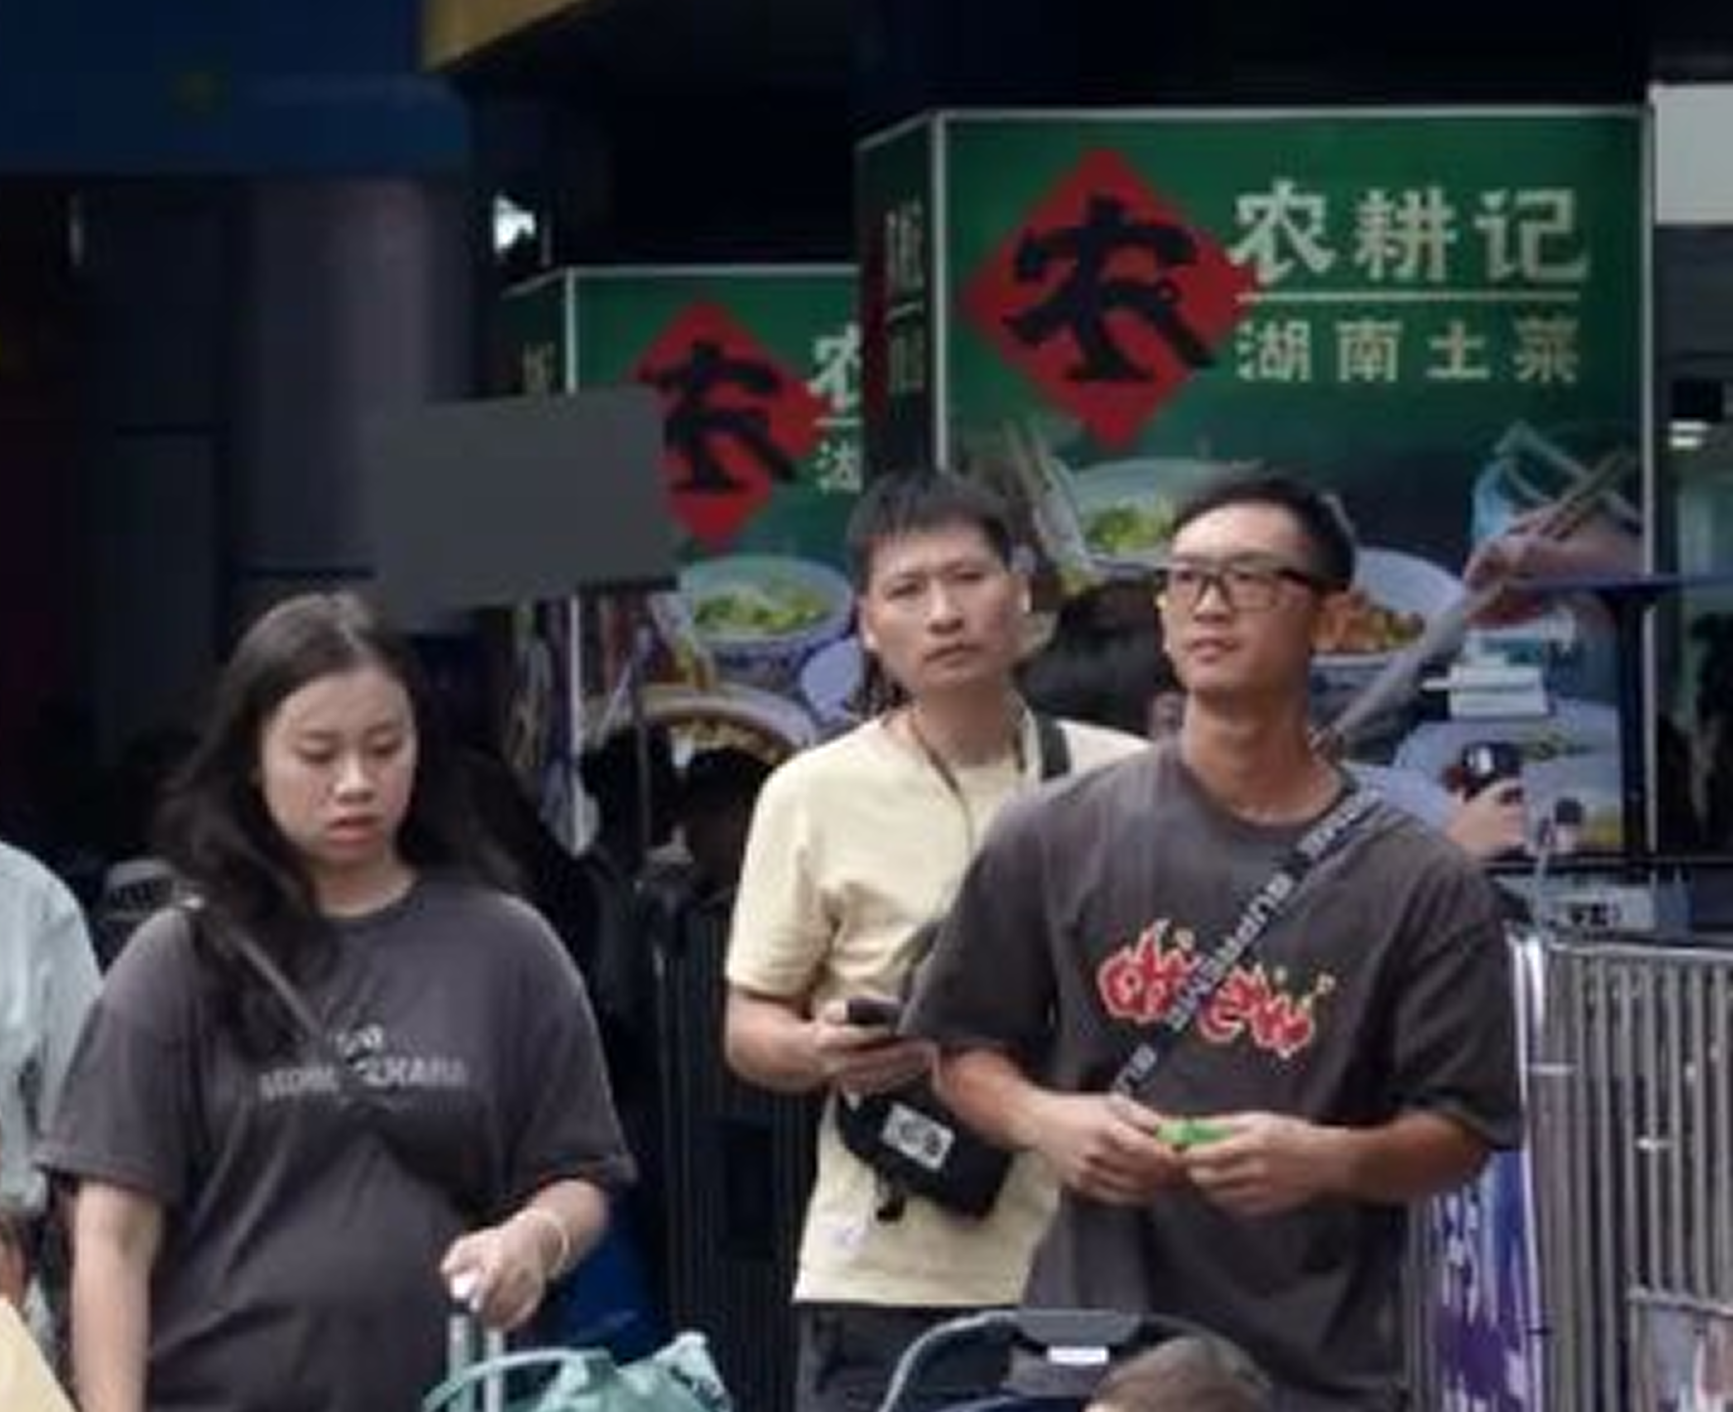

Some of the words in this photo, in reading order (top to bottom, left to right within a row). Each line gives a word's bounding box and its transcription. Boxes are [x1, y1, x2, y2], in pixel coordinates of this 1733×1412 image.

[1231, 179, 1590, 284] 农耕记
[1236, 319, 1580, 384] 湖南土菜
